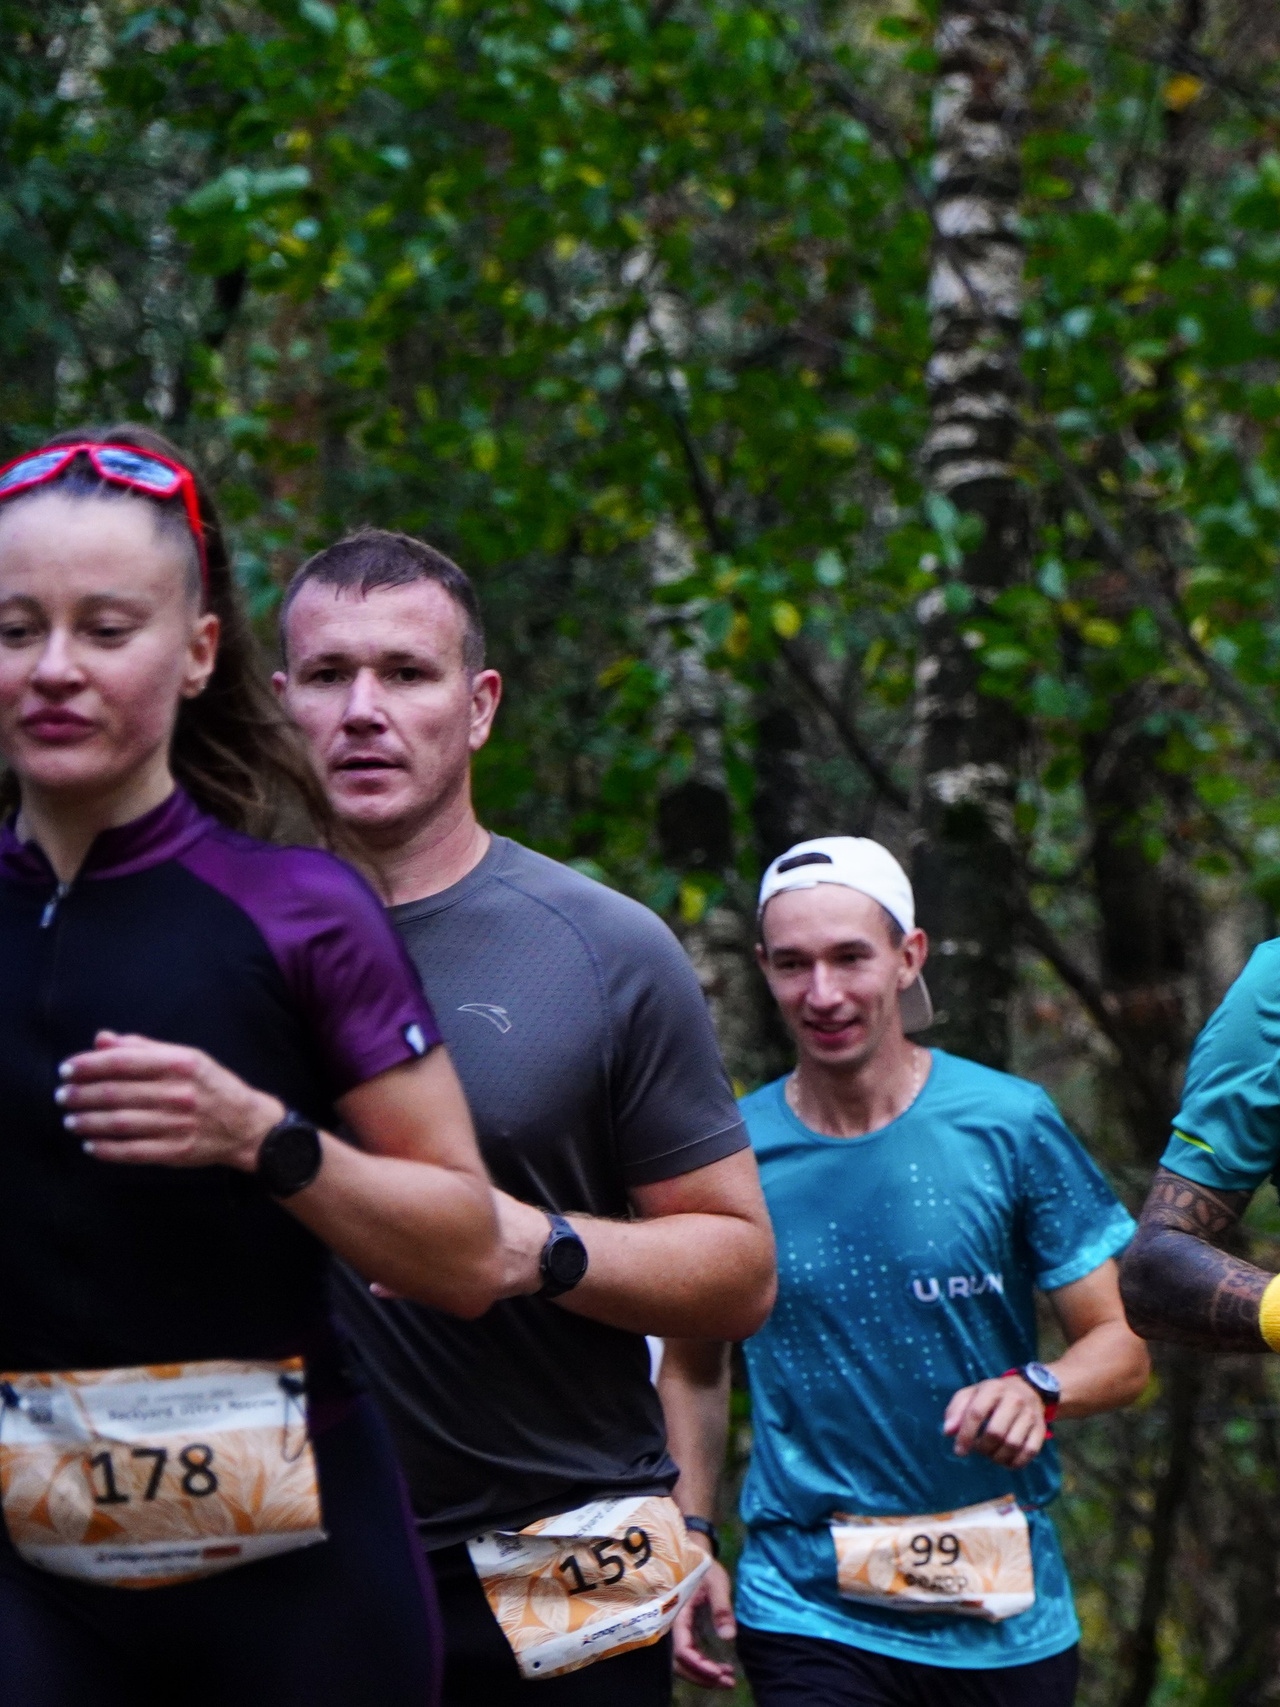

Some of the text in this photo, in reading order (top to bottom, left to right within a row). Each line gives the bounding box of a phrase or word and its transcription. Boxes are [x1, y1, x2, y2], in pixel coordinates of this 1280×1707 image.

[89, 1443, 219, 1504] 178
[559, 1526, 652, 1595] 159
[911, 1533, 960, 1567] 99
